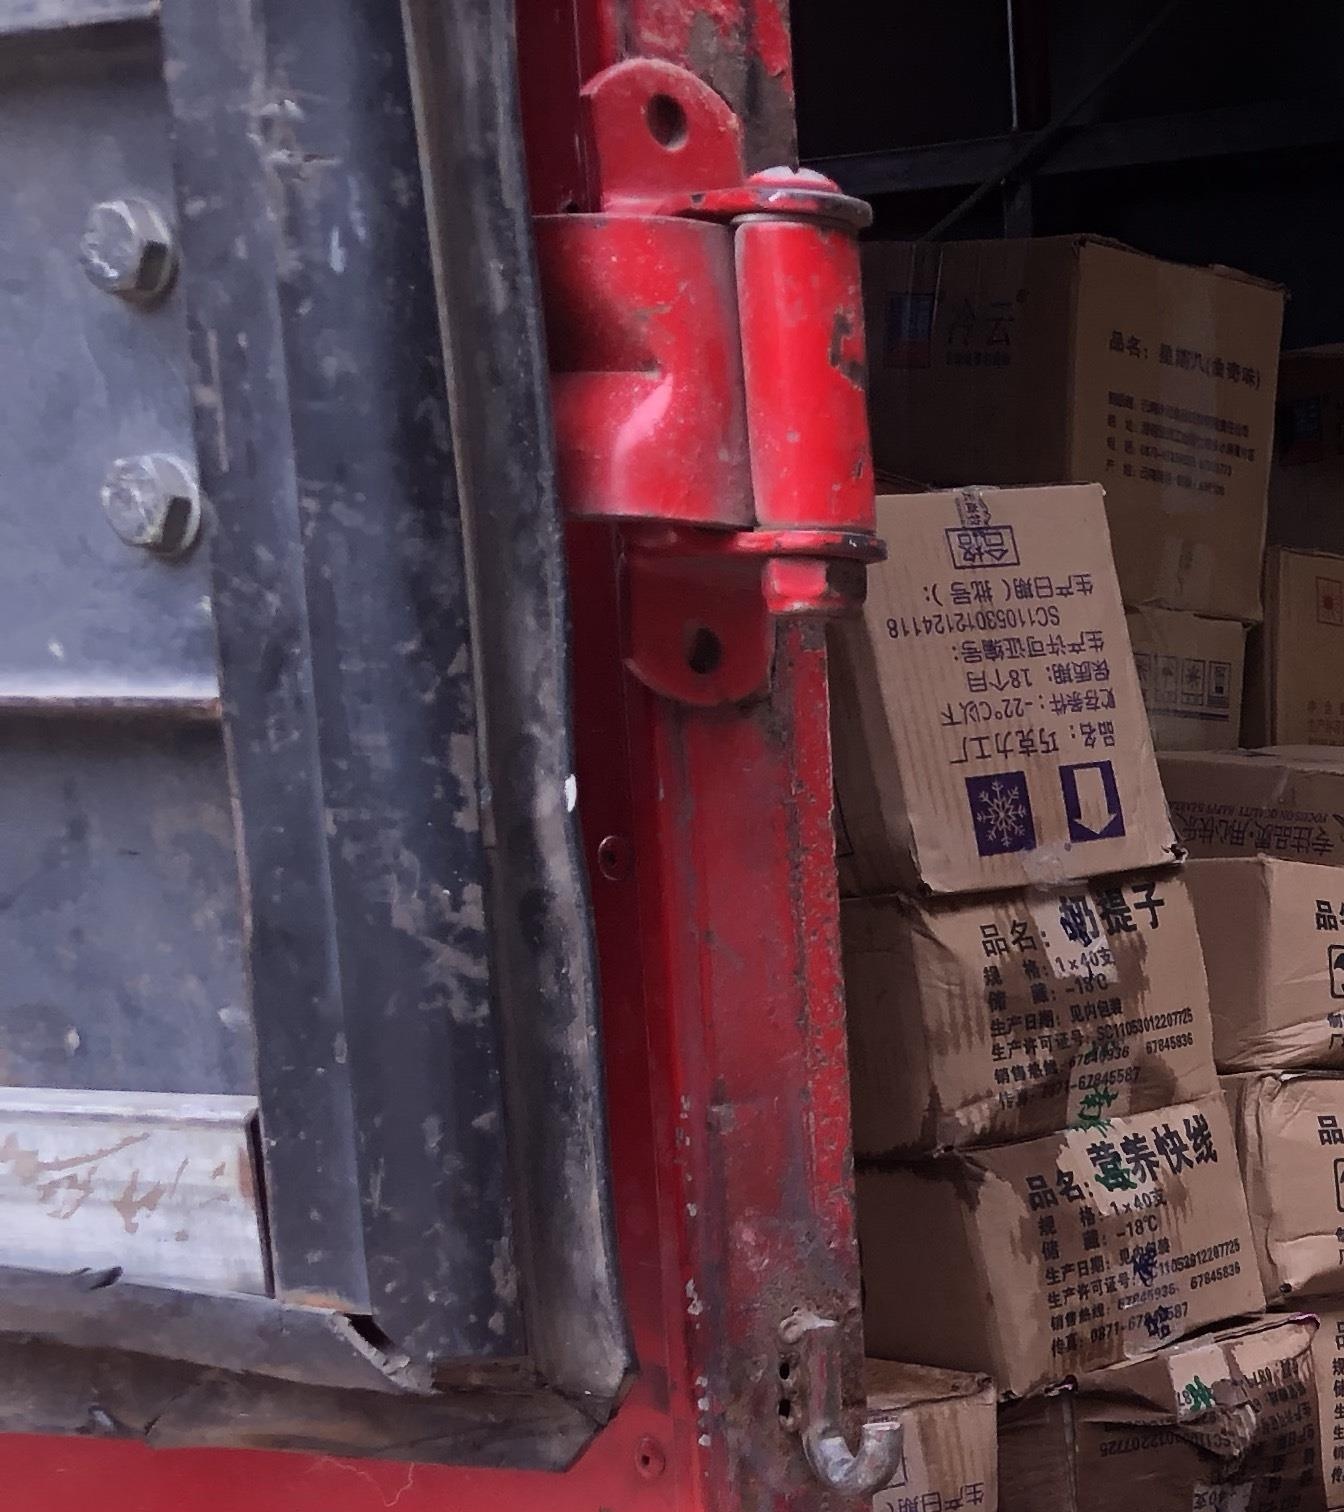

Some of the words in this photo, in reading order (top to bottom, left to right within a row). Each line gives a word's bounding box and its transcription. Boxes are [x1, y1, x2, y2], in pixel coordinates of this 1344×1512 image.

[886, 606, 1060, 638] SC11053012124118
[952, 630, 1104, 664] 生产许可证编号：
[967, 669, 1033, 692] 18个月
[1048, 659, 1110, 685] 保质期：
[950, 730, 1059, 764] 巧克力工厂
[1071, 721, 1115, 749] 品名：
[980, 920, 1050, 957] 品名：
[991, 1010, 1060, 1037] 生产日期：
[1145, 1032, 1194, 1056] 67845836
[1026, 1170, 1094, 1211] 品名：
[1045, 1256, 1111, 1286] 生产日期：
[1190, 1261, 1241, 1290] 67845836
